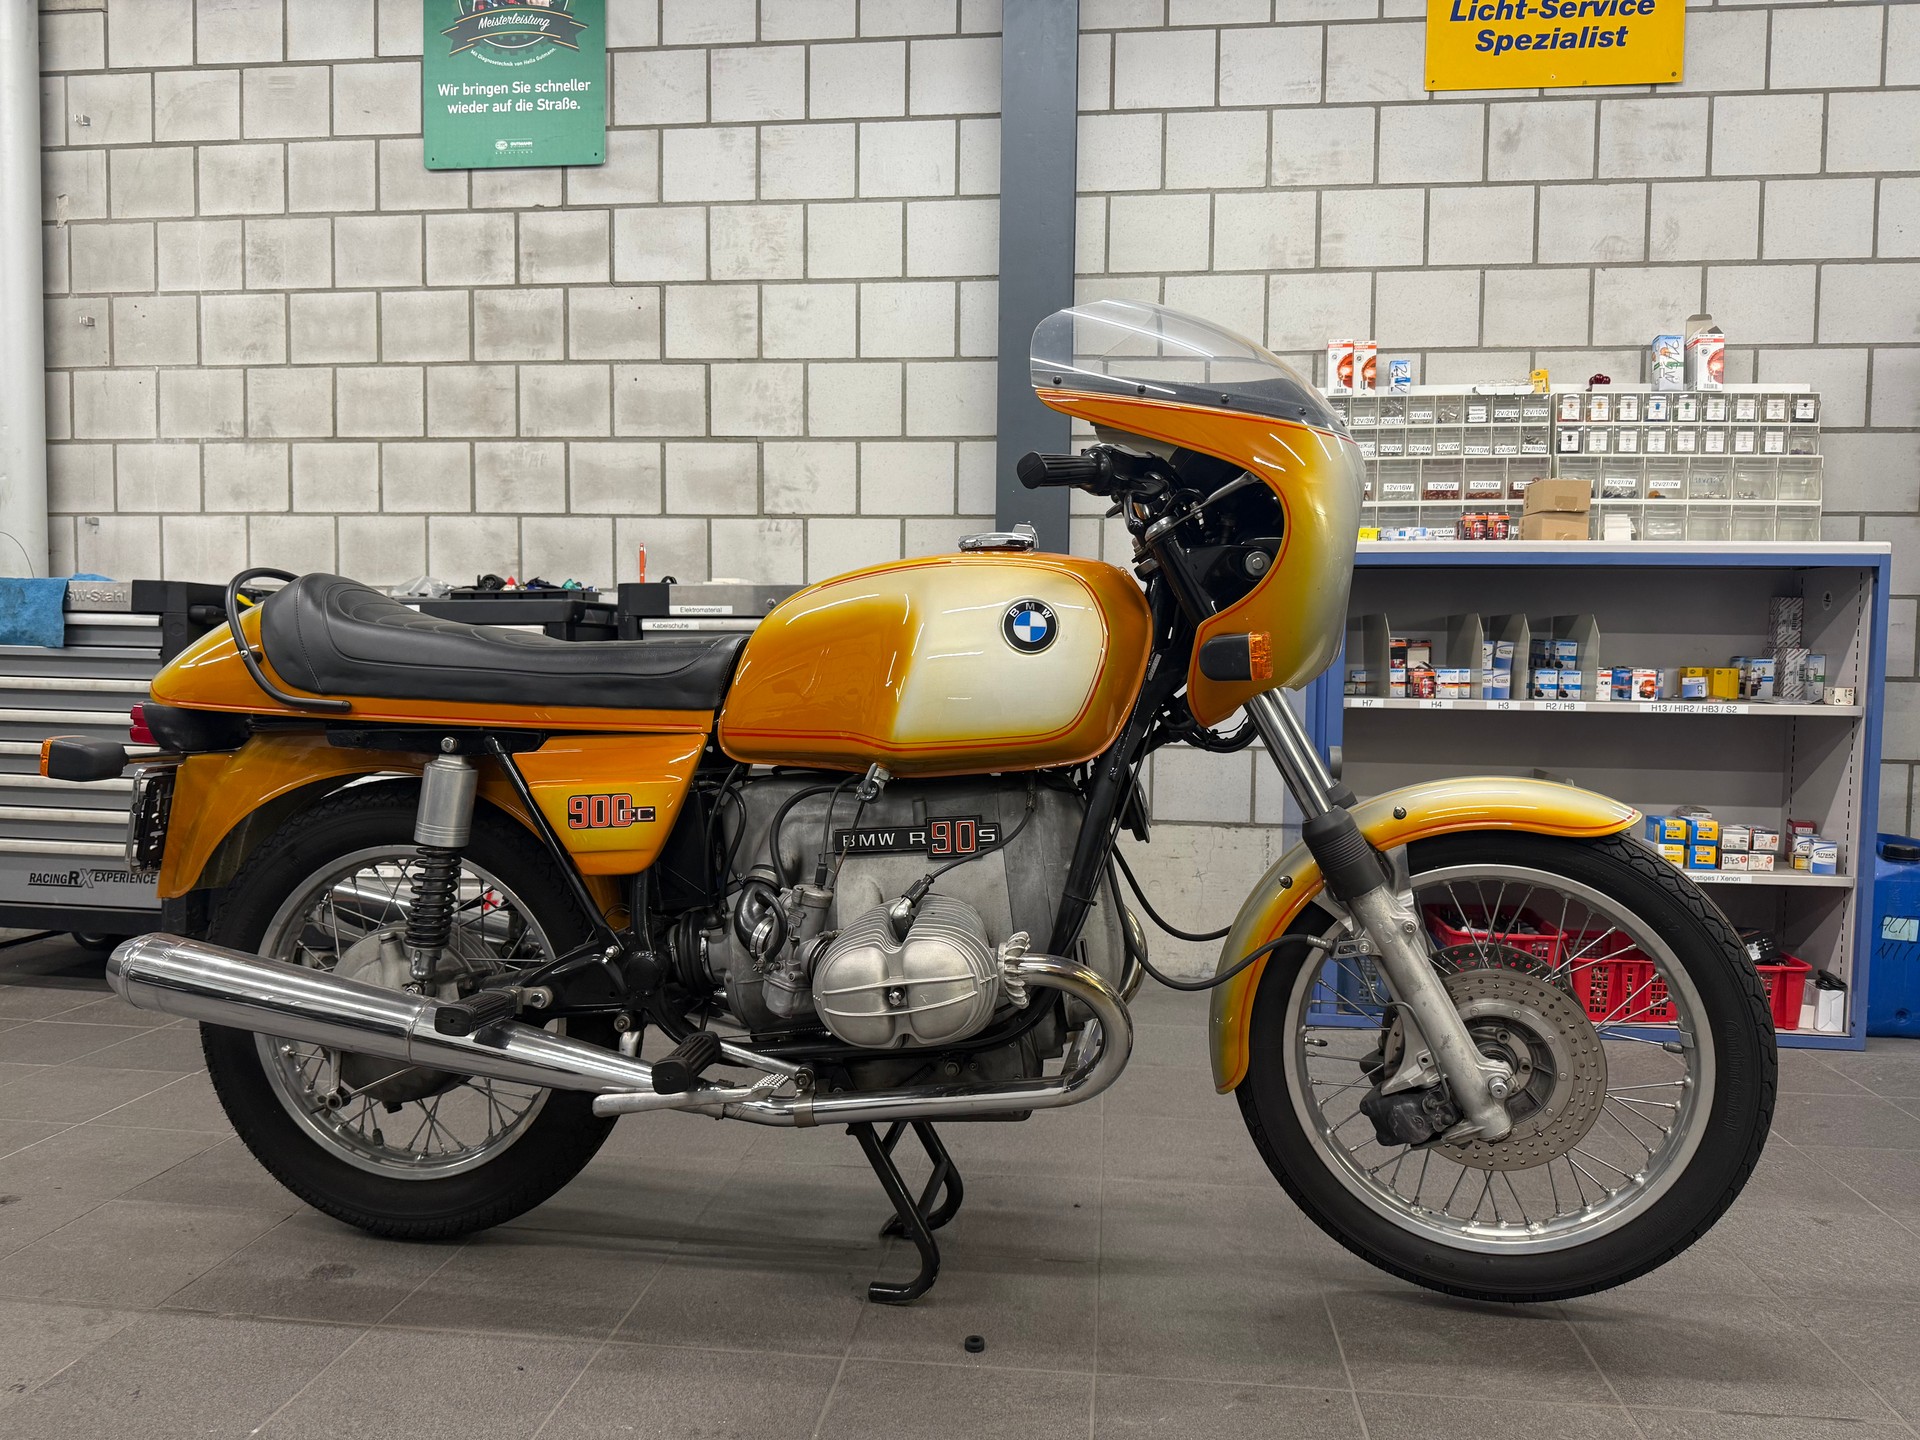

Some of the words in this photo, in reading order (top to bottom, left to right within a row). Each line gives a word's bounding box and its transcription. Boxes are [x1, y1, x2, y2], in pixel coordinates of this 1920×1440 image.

[1449, 0, 1655, 21] Licht-Service
[477, 12, 550, 32] Meisterleistung
[1475, 26, 1628, 56] Spezialist
[437, 84, 459, 96] Wir
[462, 83, 509, 97] bringen
[511, 81, 531, 93] Sie
[534, 78, 591, 93] schneller
[447, 101, 489, 114] wieder
[492, 99, 512, 112] auf
[515, 99, 534, 111] die
[536, 97, 581, 111] Straße.
[1409, 411, 1432, 419] 24V/4W
[1465, 446, 1489, 454] 12V/10W
[1009, 602, 1052, 619] BMW
[842, 832, 896, 847] BMW
[28, 872, 67, 885] RACING
[94, 872, 156, 885] EXPERIENCE
